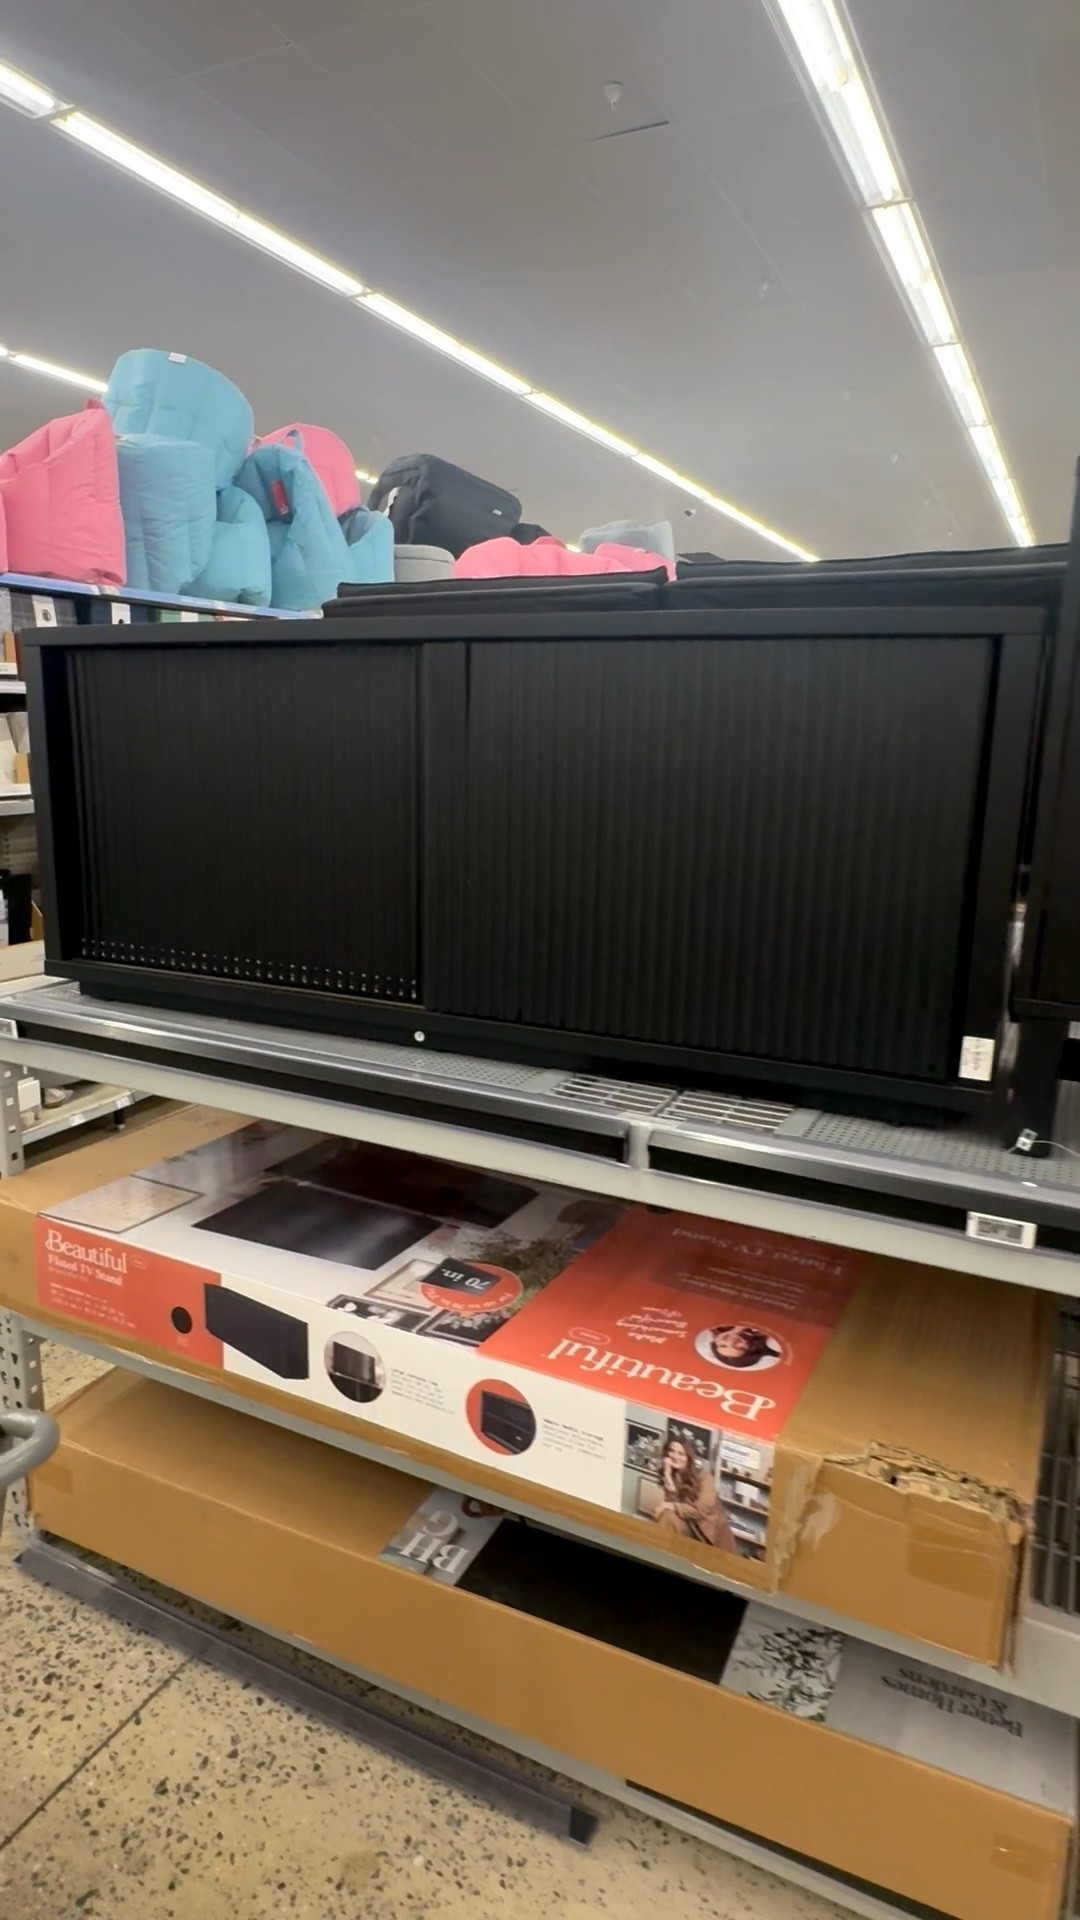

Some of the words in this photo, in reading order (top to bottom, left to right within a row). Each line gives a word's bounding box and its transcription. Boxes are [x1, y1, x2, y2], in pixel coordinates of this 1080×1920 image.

[45, 1229, 128, 1274] Beautiful
[671, 1228, 731, 1251] Stand
[731, 1244, 764, 1258] TV
[48, 1254, 78, 1271] Fluted
[80, 1264, 94, 1276] TV
[95, 1269, 123, 1286] Stand
[441, 1269, 464, 1281] in.
[771, 1252, 844, 1275] Fluted
[464, 1277, 491, 1290] 70
[545, 1338, 778, 1421] Beautiful
[422, 1510, 459, 1537] G
[398, 1532, 469, 1574] BH
[880, 1676, 954, 1714] Homes
[898, 1667, 988, 1709] Gardens
[958, 1703, 1024, 1740] Better
[990, 1699, 1008, 1716] &
